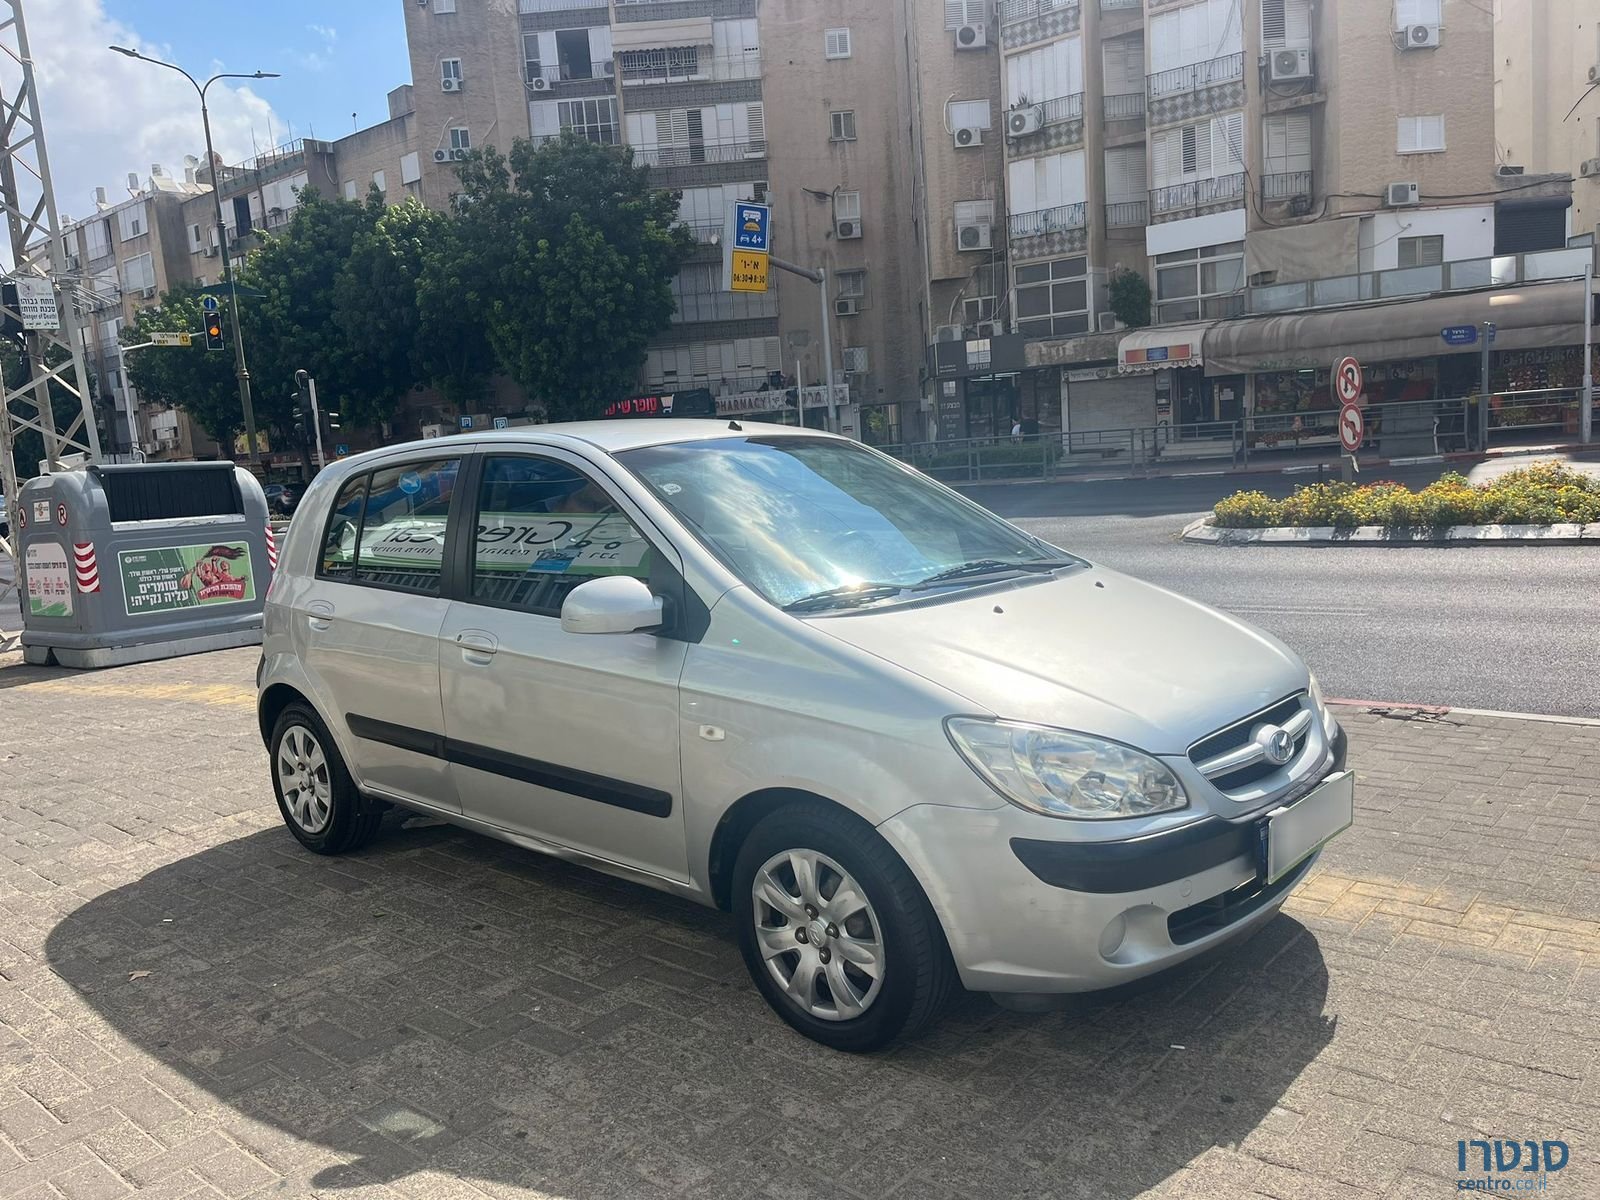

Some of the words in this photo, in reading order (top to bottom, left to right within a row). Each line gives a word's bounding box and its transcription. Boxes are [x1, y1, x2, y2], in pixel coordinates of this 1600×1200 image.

[715, 397, 767, 412] PHARMACY
[138, 580, 179, 594] שומרים
[130, 594, 162, 607] נקייה!
[164, 590, 189, 603] עליה
